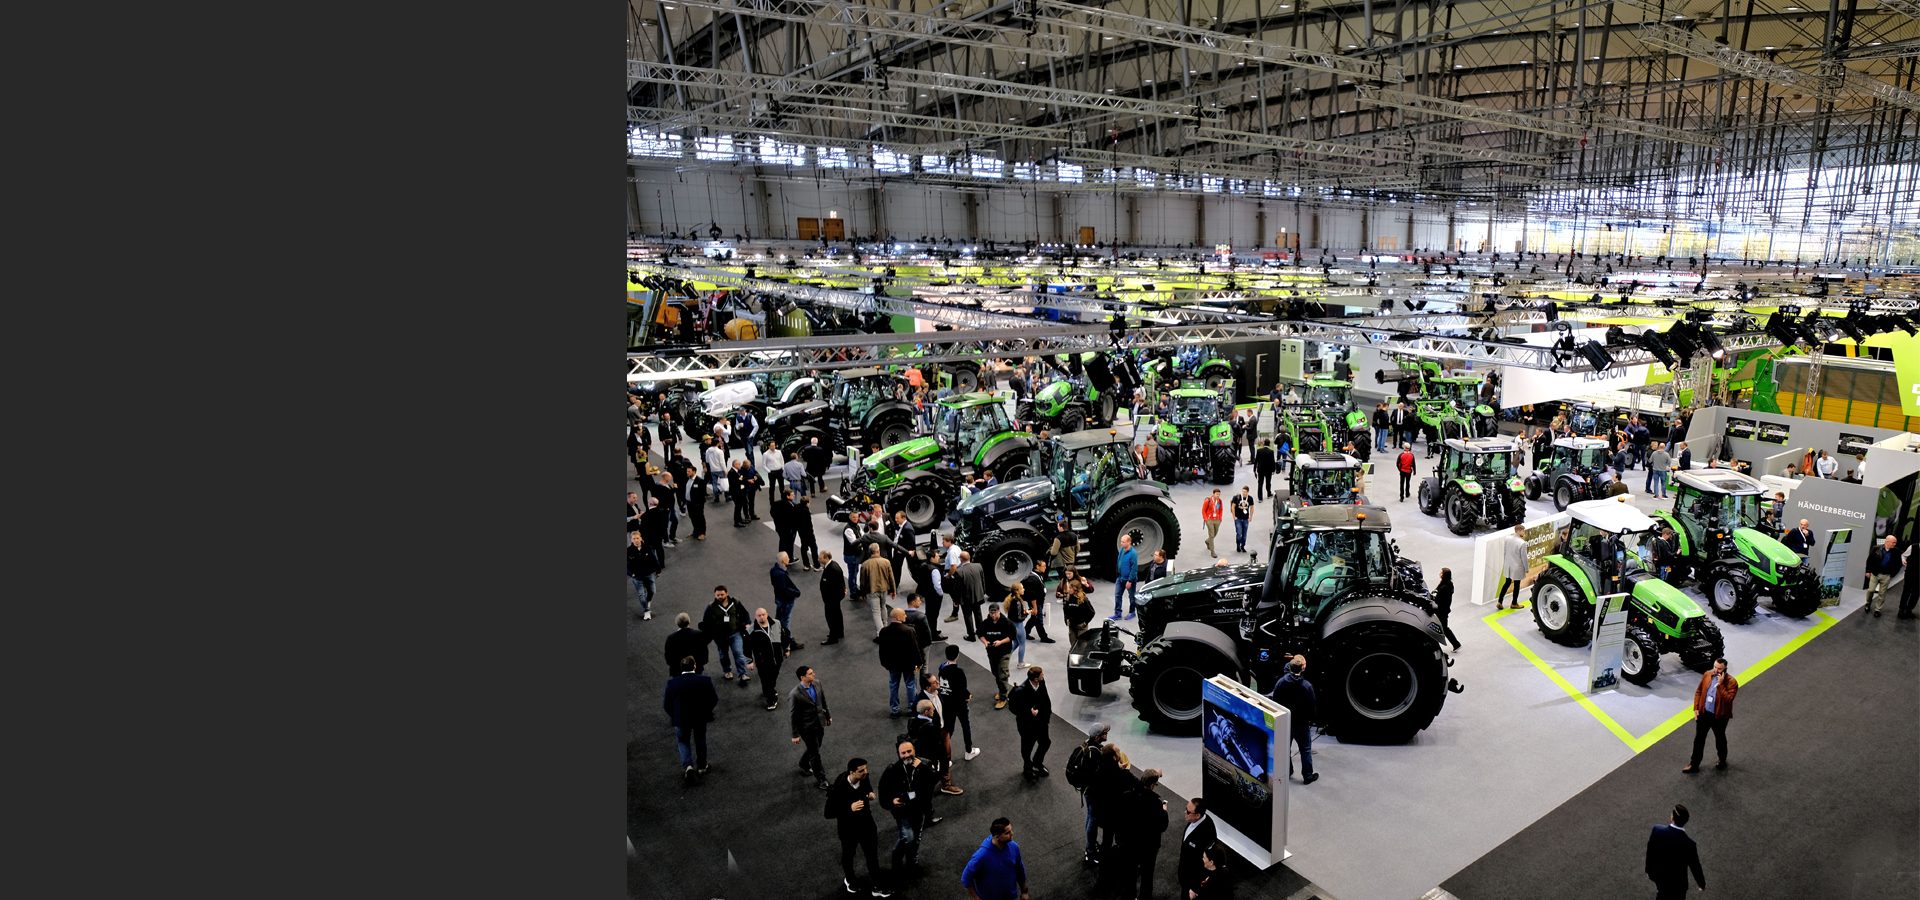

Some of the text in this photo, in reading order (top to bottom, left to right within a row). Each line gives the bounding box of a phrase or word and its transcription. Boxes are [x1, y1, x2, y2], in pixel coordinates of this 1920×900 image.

[1583, 366, 1627, 383] REGION
[1797, 500, 1866, 520] HÄNDLERBEREICH
[1526, 547, 1546, 560] egion
